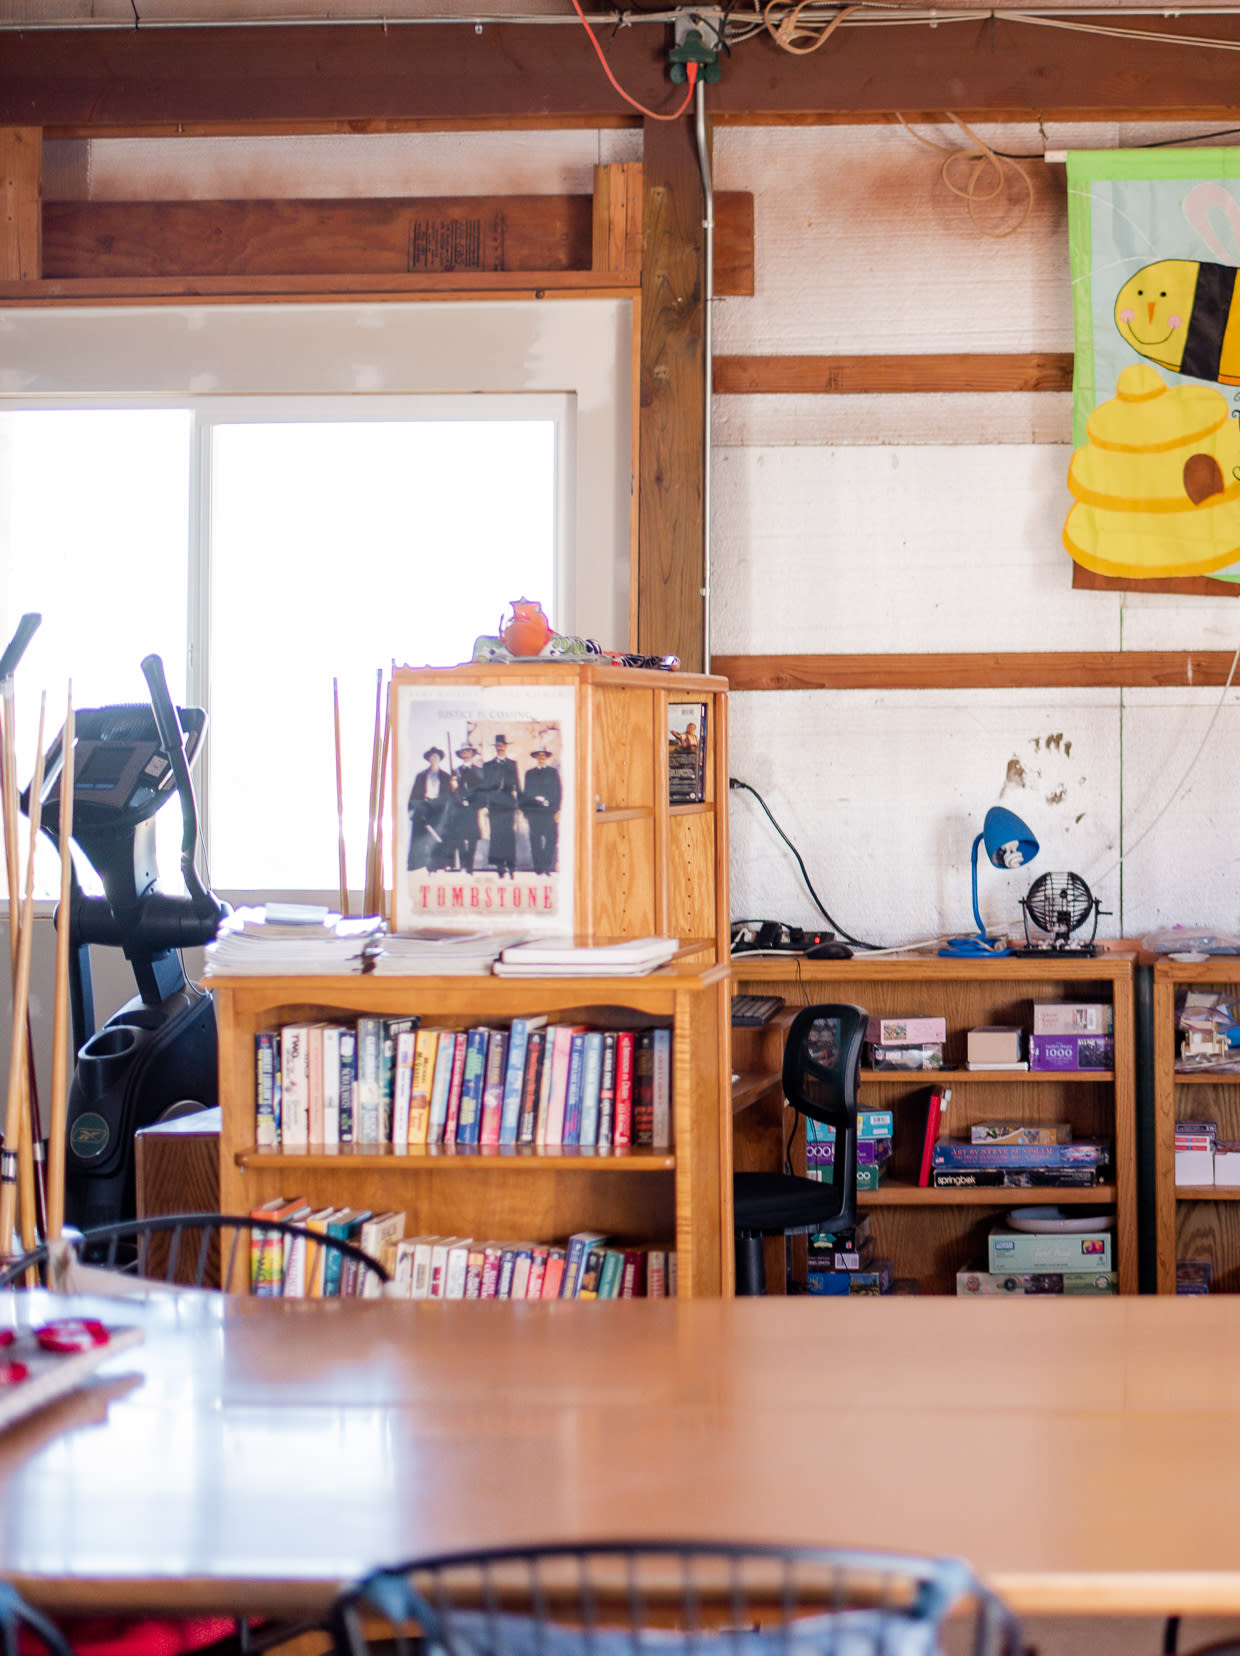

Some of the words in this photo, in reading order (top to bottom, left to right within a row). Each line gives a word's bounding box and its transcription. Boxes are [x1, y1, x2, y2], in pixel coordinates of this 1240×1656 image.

[489, 710, 533, 720] COMING
[419, 886, 553, 909] TOMBSTONE
[291, 1034, 300, 1058] TWO
[1045, 1048, 1073, 1058] 1000
